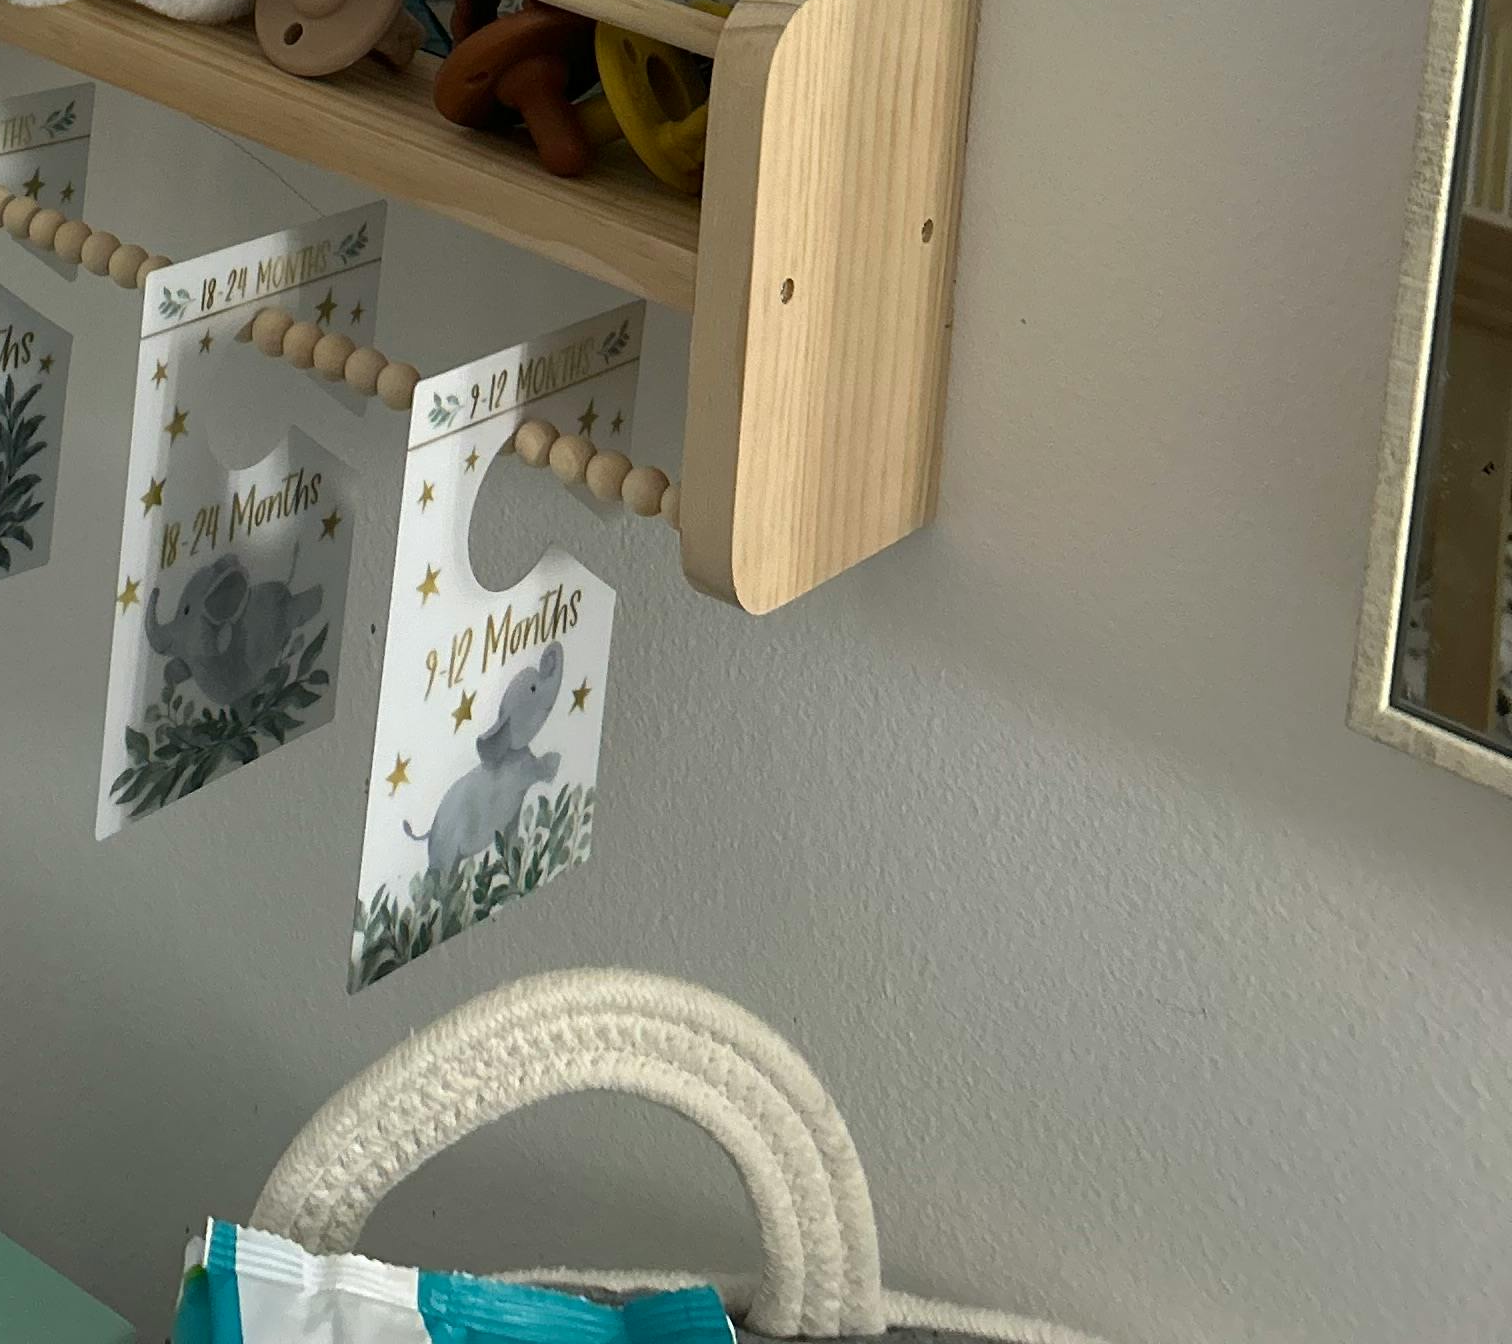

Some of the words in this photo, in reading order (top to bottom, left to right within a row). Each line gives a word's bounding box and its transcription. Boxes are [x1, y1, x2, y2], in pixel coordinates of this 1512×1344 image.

[200, 267, 248, 312] 18-24
[257, 241, 331, 295] MONTHS
[469, 375, 508, 418] 9-12
[516, 337, 594, 401] MONTHS
[159, 503, 221, 569] 18-24
[229, 468, 322, 543] Months
[425, 628, 473, 701] 9-12
[481, 585, 582, 674] Months
